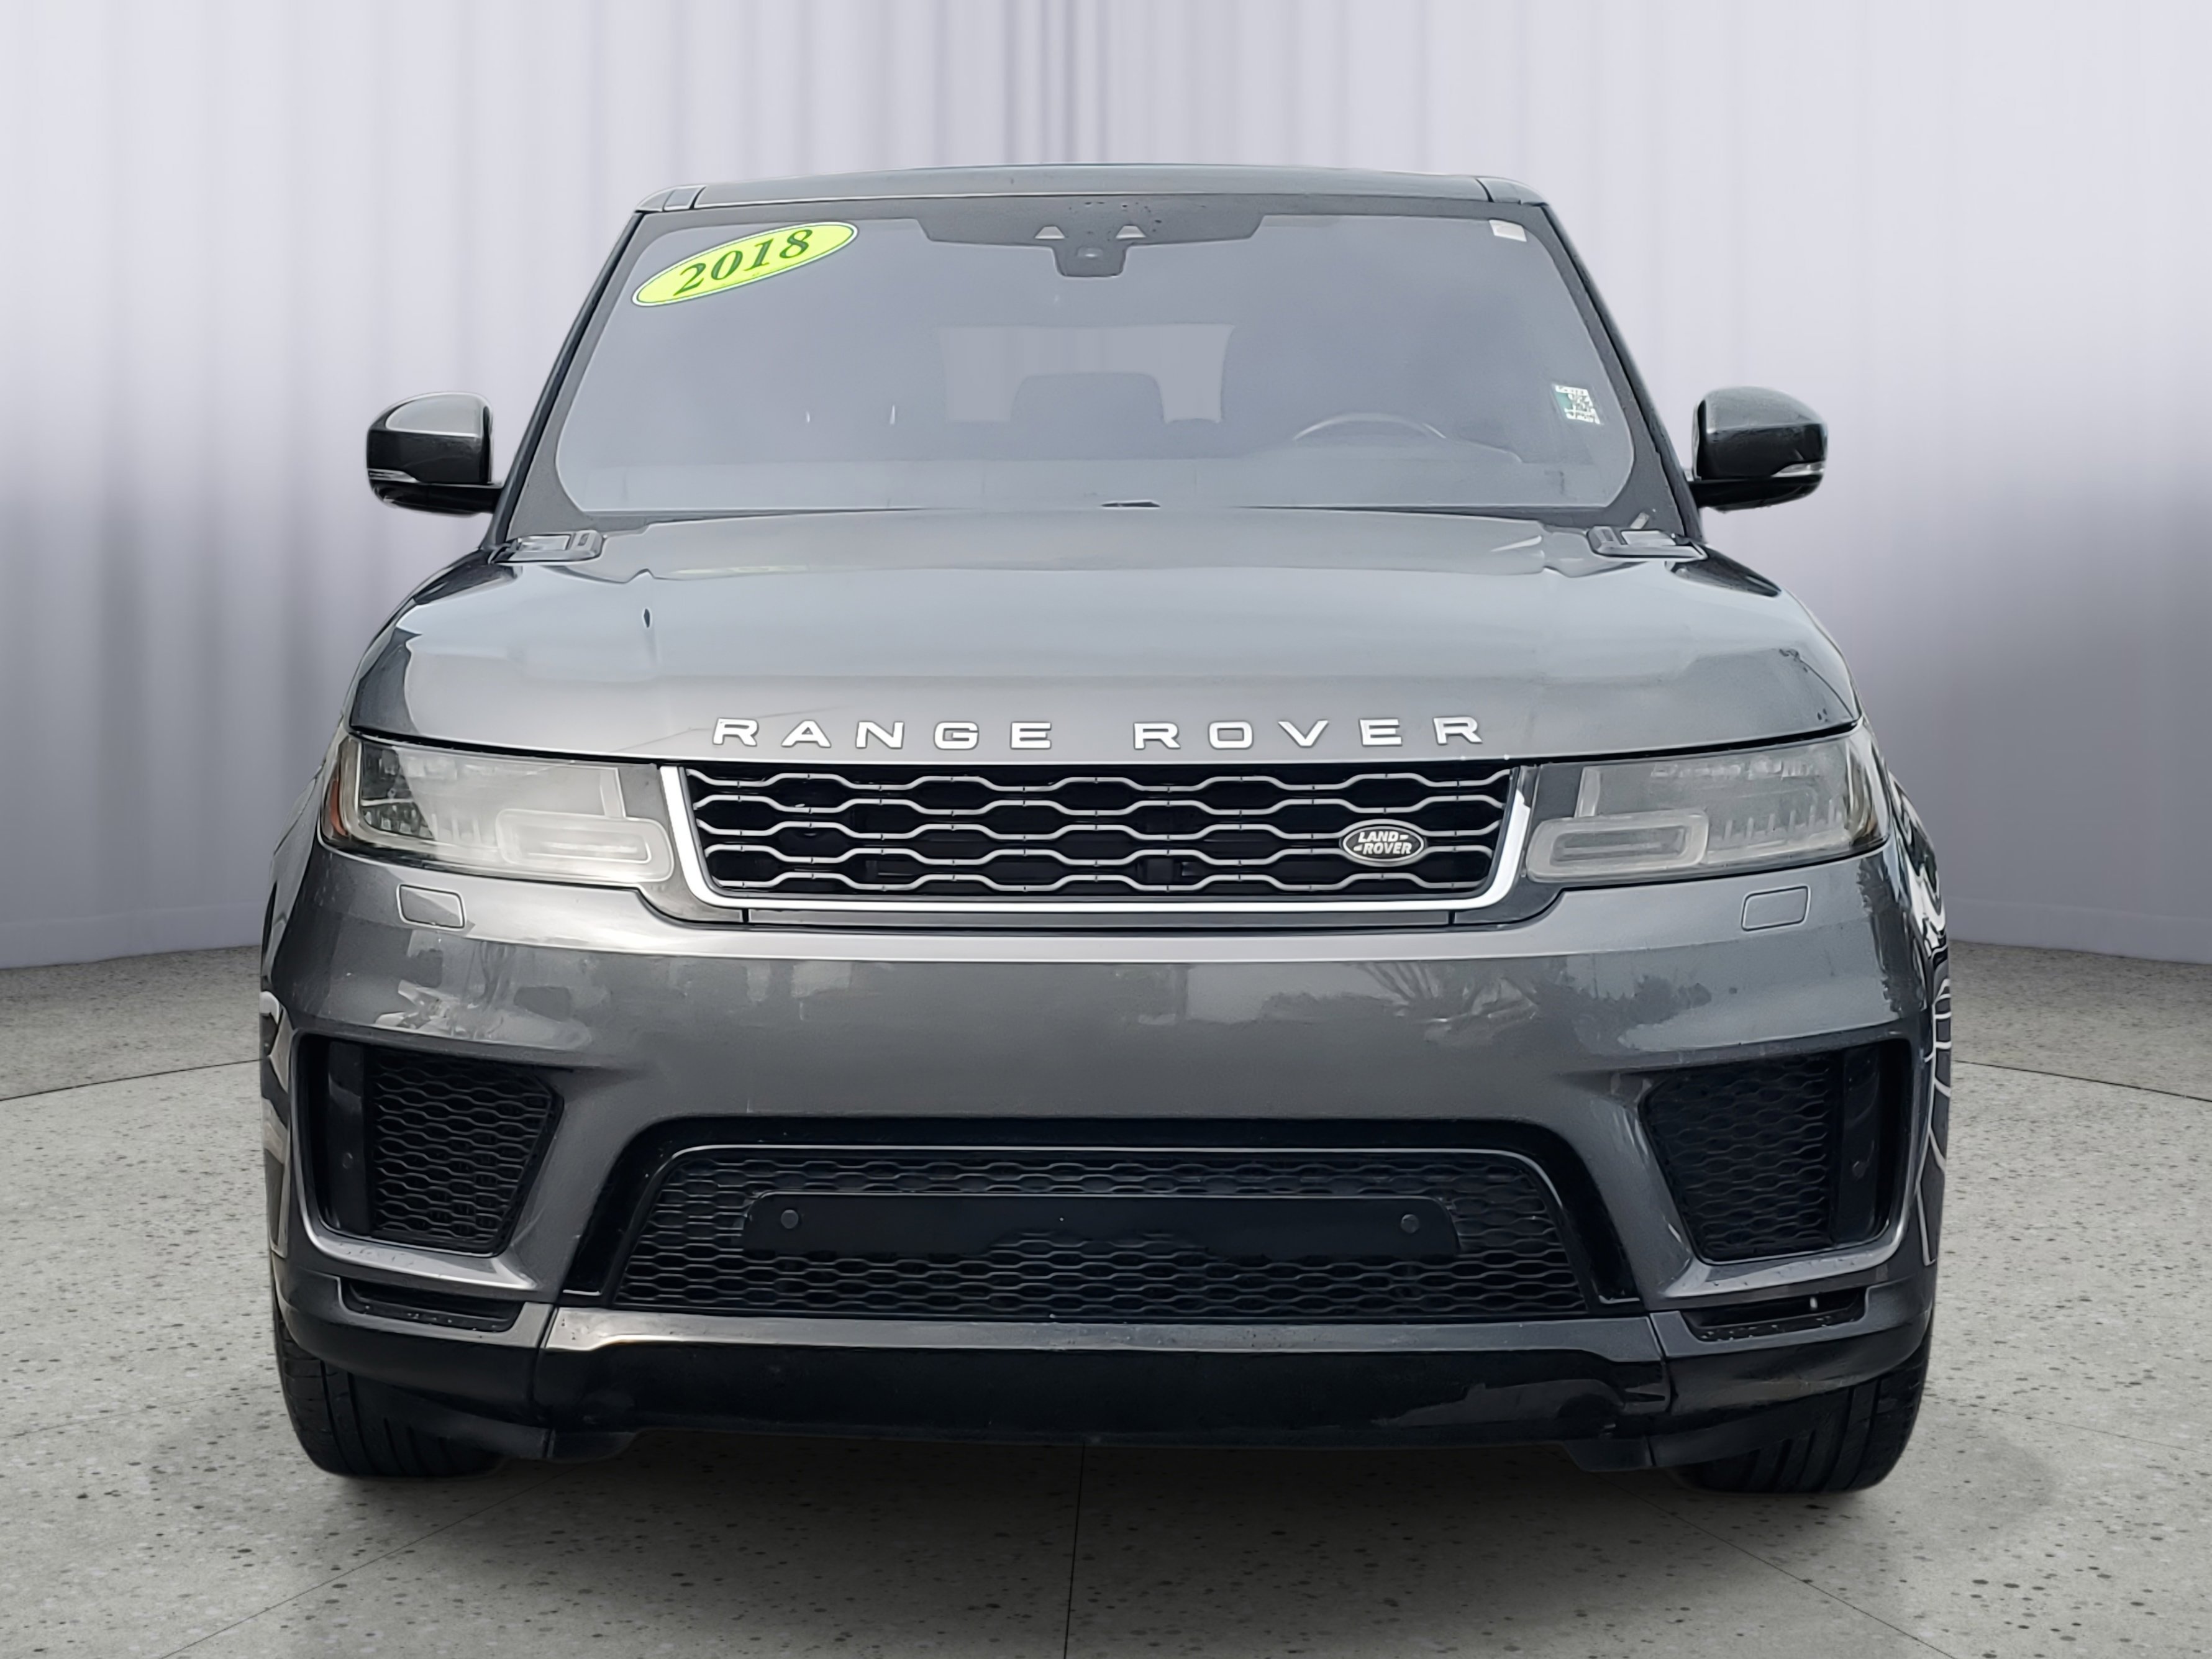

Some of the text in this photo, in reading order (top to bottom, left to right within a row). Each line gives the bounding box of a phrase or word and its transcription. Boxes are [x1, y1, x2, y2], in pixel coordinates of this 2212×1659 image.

[673, 229, 813, 296] 2018
[712, 716, 1483, 749] RANGE ROVER
[1358, 831, 1398, 843] LAND
[1362, 842, 1413, 855] ROVER
